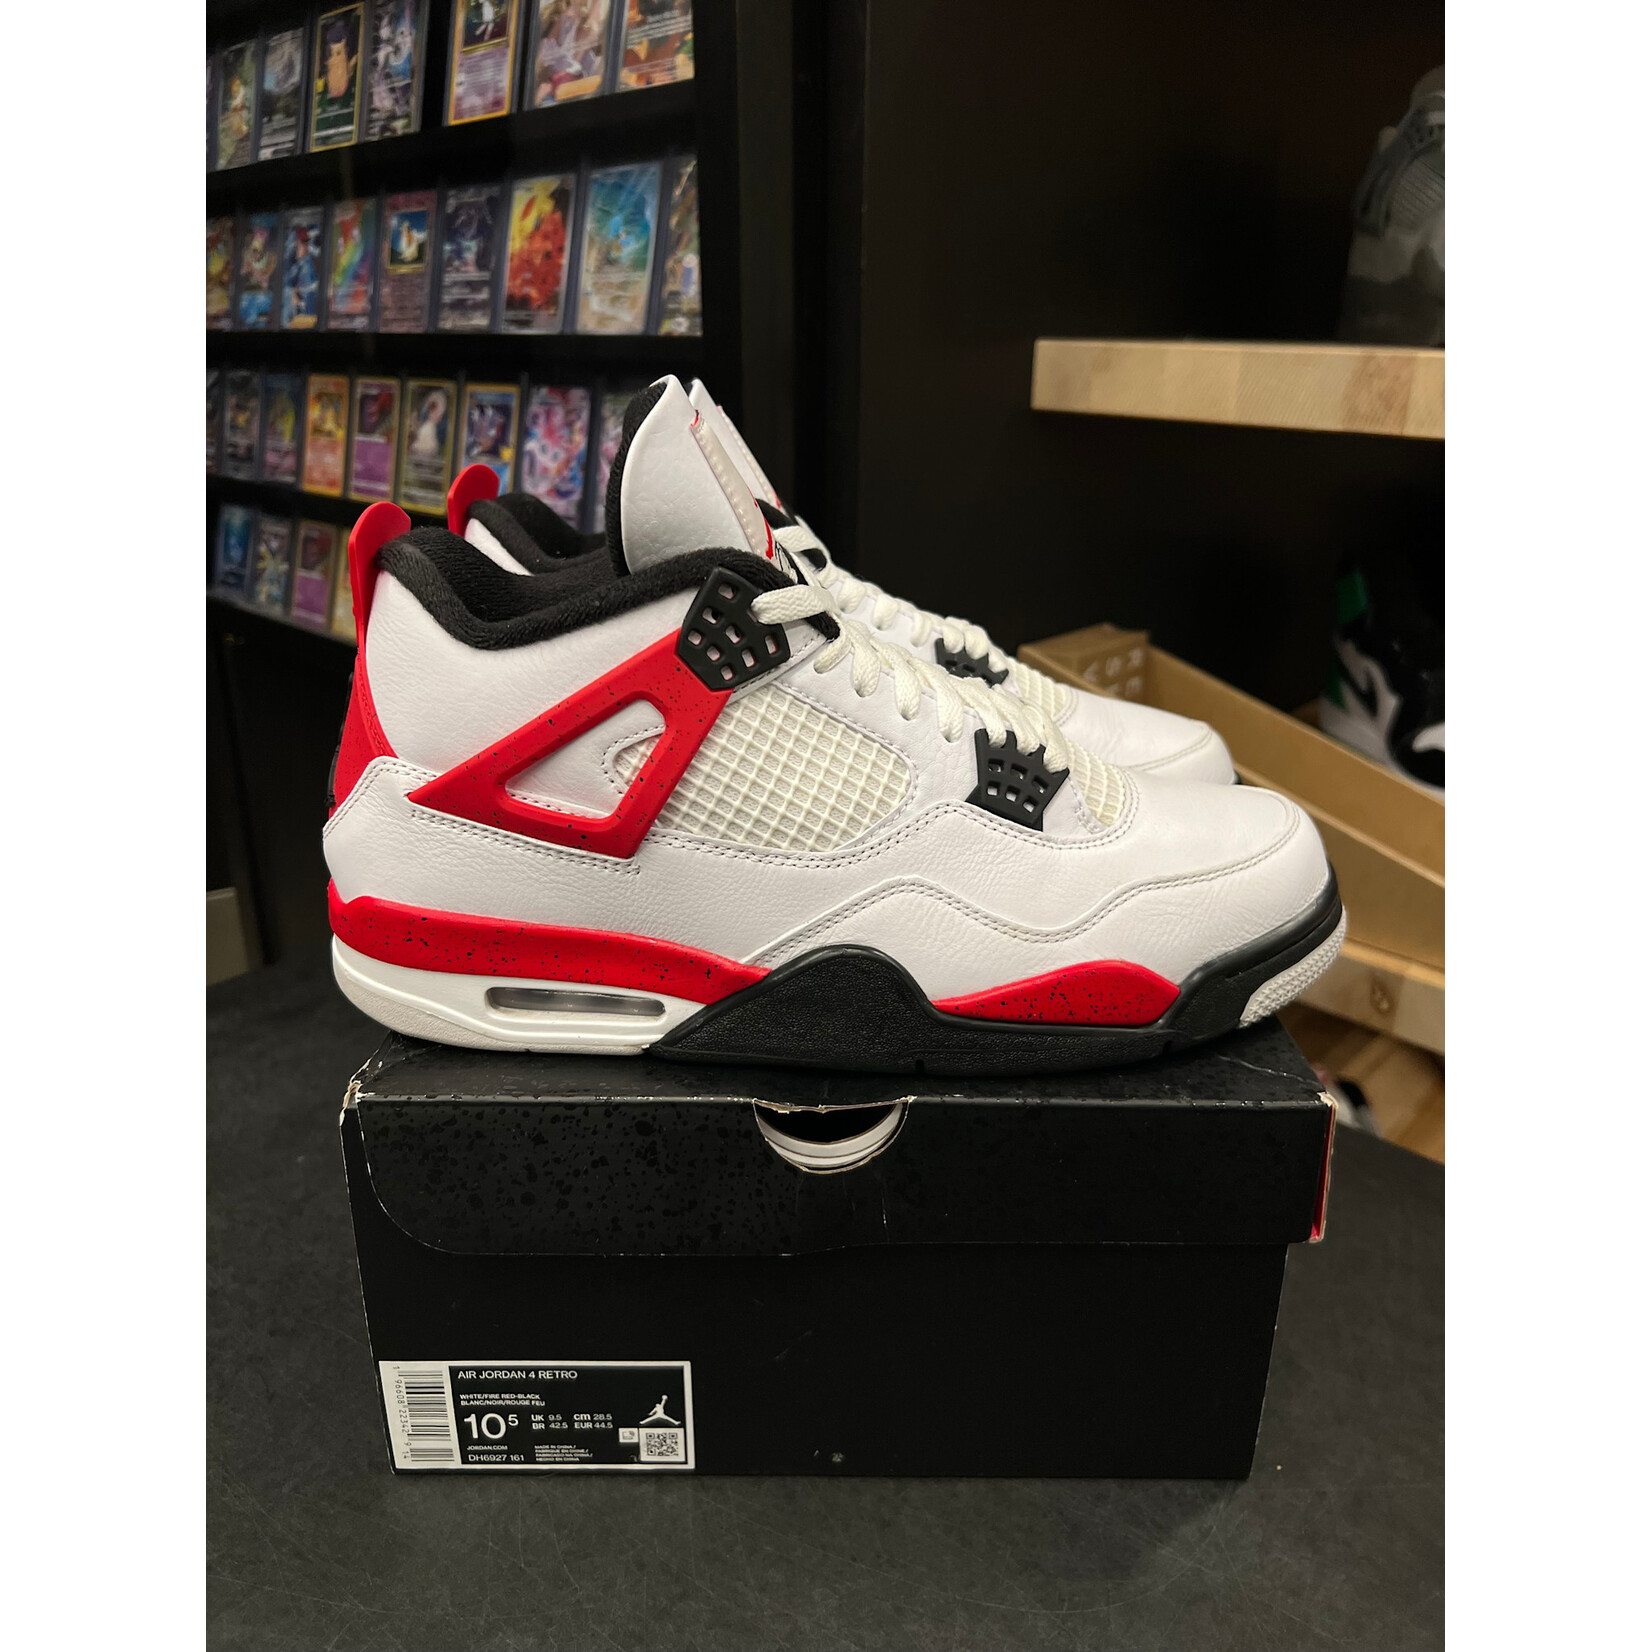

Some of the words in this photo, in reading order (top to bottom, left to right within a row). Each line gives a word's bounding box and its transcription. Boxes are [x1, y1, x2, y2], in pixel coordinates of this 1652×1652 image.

[457, 1370, 477, 1379] AIR
[479, 1370, 526, 1379] JORDAN
[528, 1370, 536, 1379] 4
[538, 1370, 578, 1379] RETRO
[394, 1379, 405, 1405] 96608
[398, 1409, 409, 1434] 22342
[531, 1413, 545, 1422] UK
[548, 1413, 562, 1421] 9.5
[573, 1413, 591, 1421] cm
[592, 1413, 613, 1421] 28.5
[532, 1422, 546, 1430] BR
[549, 1421, 568, 1429] 42.5
[574, 1421, 593, 1430] EUR
[593, 1421, 613, 1429] 44.5
[468, 1453, 507, 1462] DH6927
[509, 1454, 525, 1462] 161
